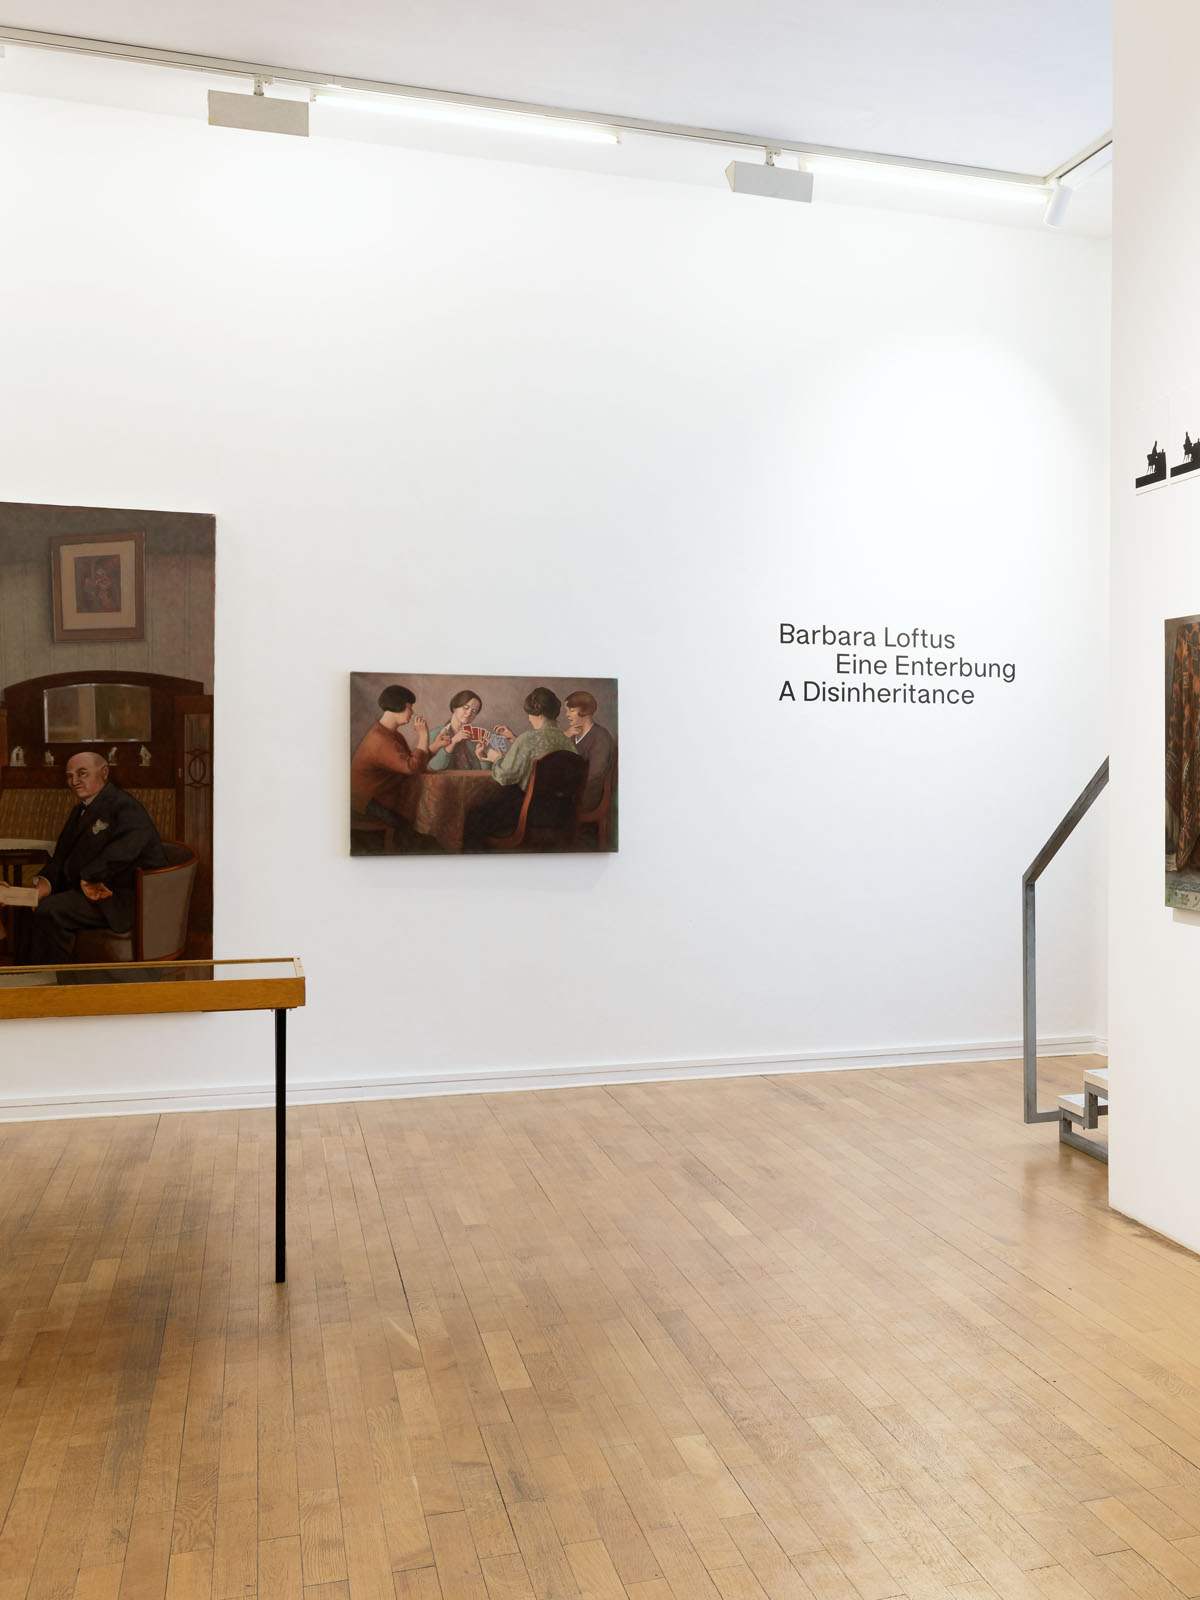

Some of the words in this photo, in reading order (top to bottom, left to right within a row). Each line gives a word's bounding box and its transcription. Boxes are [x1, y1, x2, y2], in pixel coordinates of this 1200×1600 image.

[779, 623, 876, 647] Barbara
[884, 626, 955, 650] Loftus
[836, 653, 888, 675] Eine
[895, 655, 1016, 684] Enterbung
[778, 680, 796, 702] A
[803, 680, 975, 705] Disinheritance
